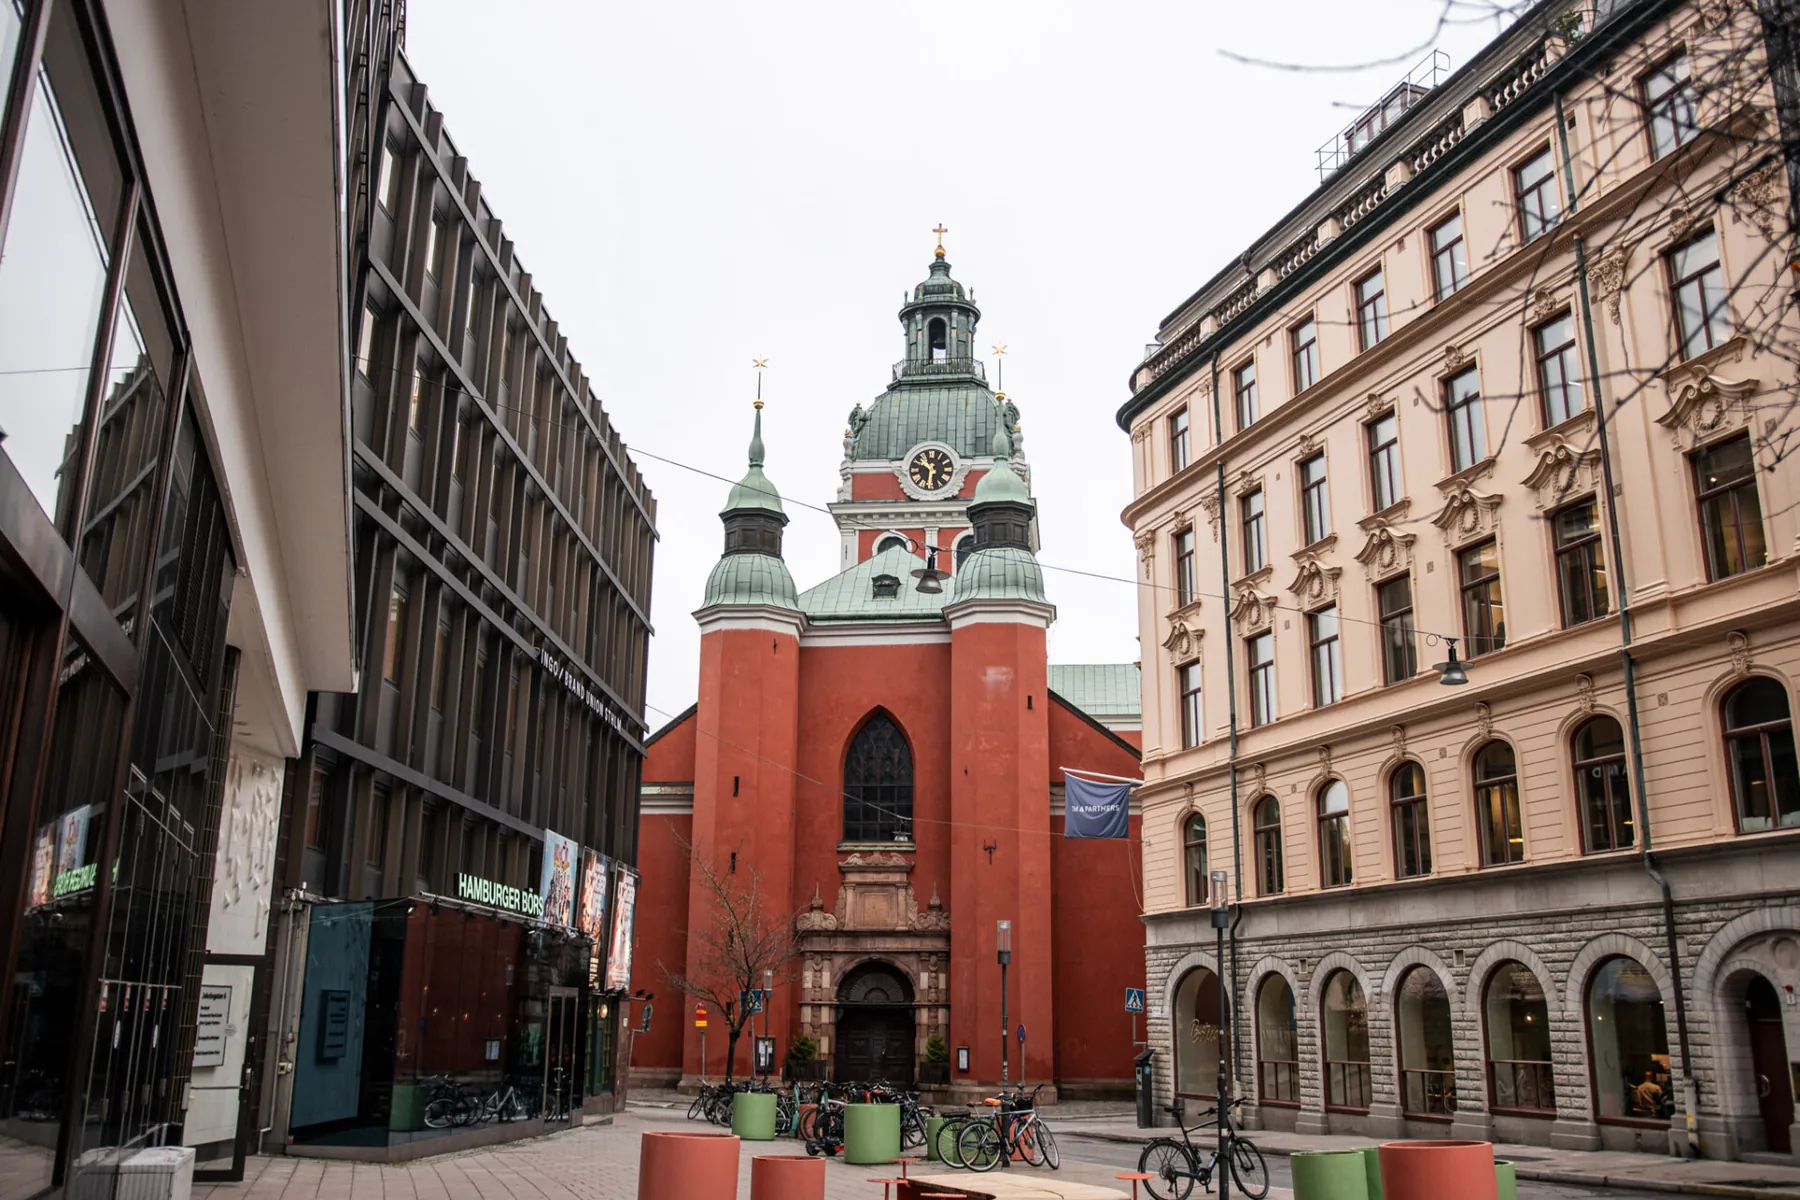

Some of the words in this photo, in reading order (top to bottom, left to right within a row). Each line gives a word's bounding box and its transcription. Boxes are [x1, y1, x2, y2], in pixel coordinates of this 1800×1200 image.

[541, 648, 559, 676] INGO
[564, 671, 585, 700] BRAND
[586, 690, 604, 717] UNION
[1084, 804, 1120, 813] PARTNERS
[459, 872, 521, 911] HAMBURGER
[521, 887, 544, 916] BÖRS
